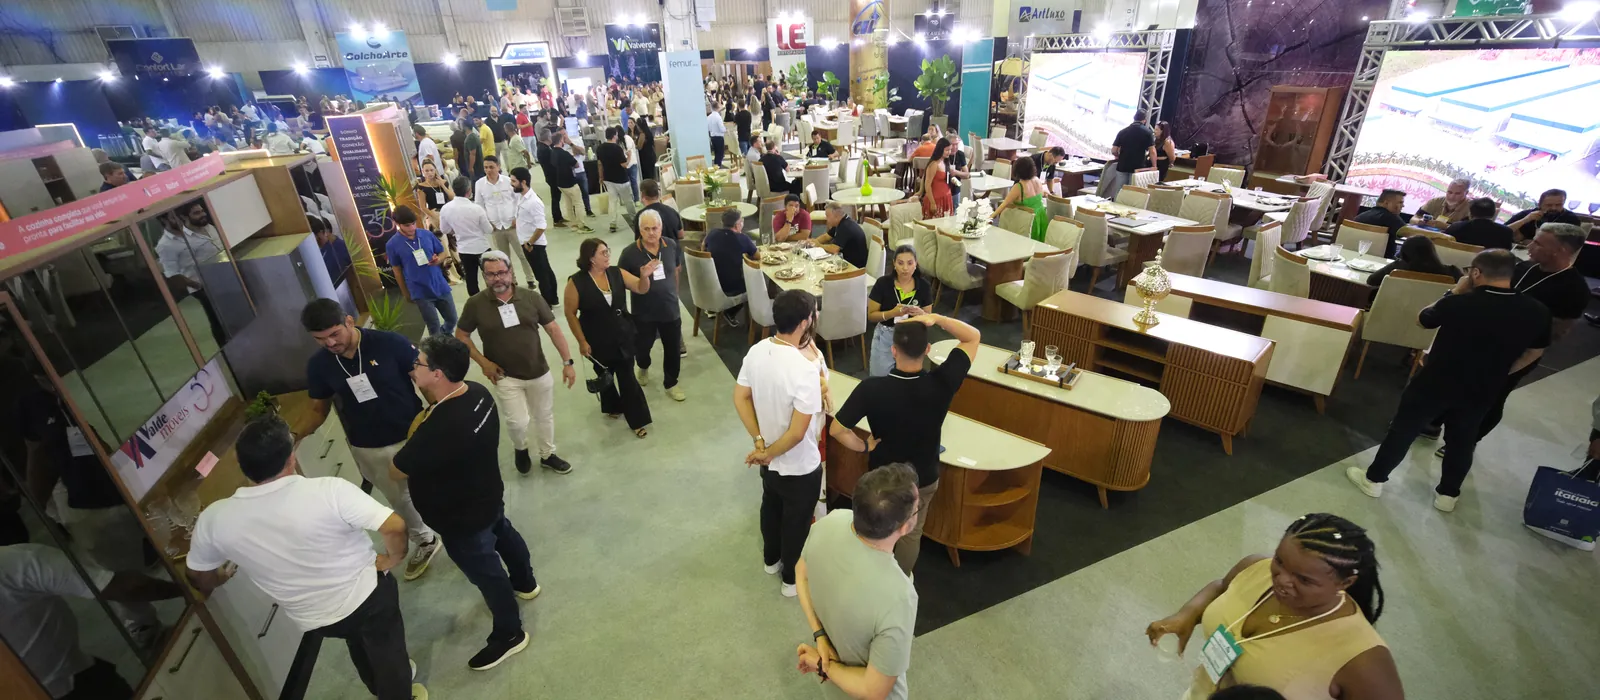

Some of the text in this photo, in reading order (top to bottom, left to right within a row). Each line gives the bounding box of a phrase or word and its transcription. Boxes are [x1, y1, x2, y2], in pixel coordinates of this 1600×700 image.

[1031, 8, 1065, 19] ArtLuxo
[628, 41, 657, 49] Valverde
[346, 51, 408, 60] ColchoArte
[669, 60, 692, 68] femur
[18, 224, 26, 233] A
[26, 217, 53, 231] cozinha
[53, 208, 81, 222] completa
[23, 229, 48, 244] pronta
[48, 224, 64, 237] para
[139, 414, 168, 441] Valde
[1554, 490, 1598, 507] itatiaia
